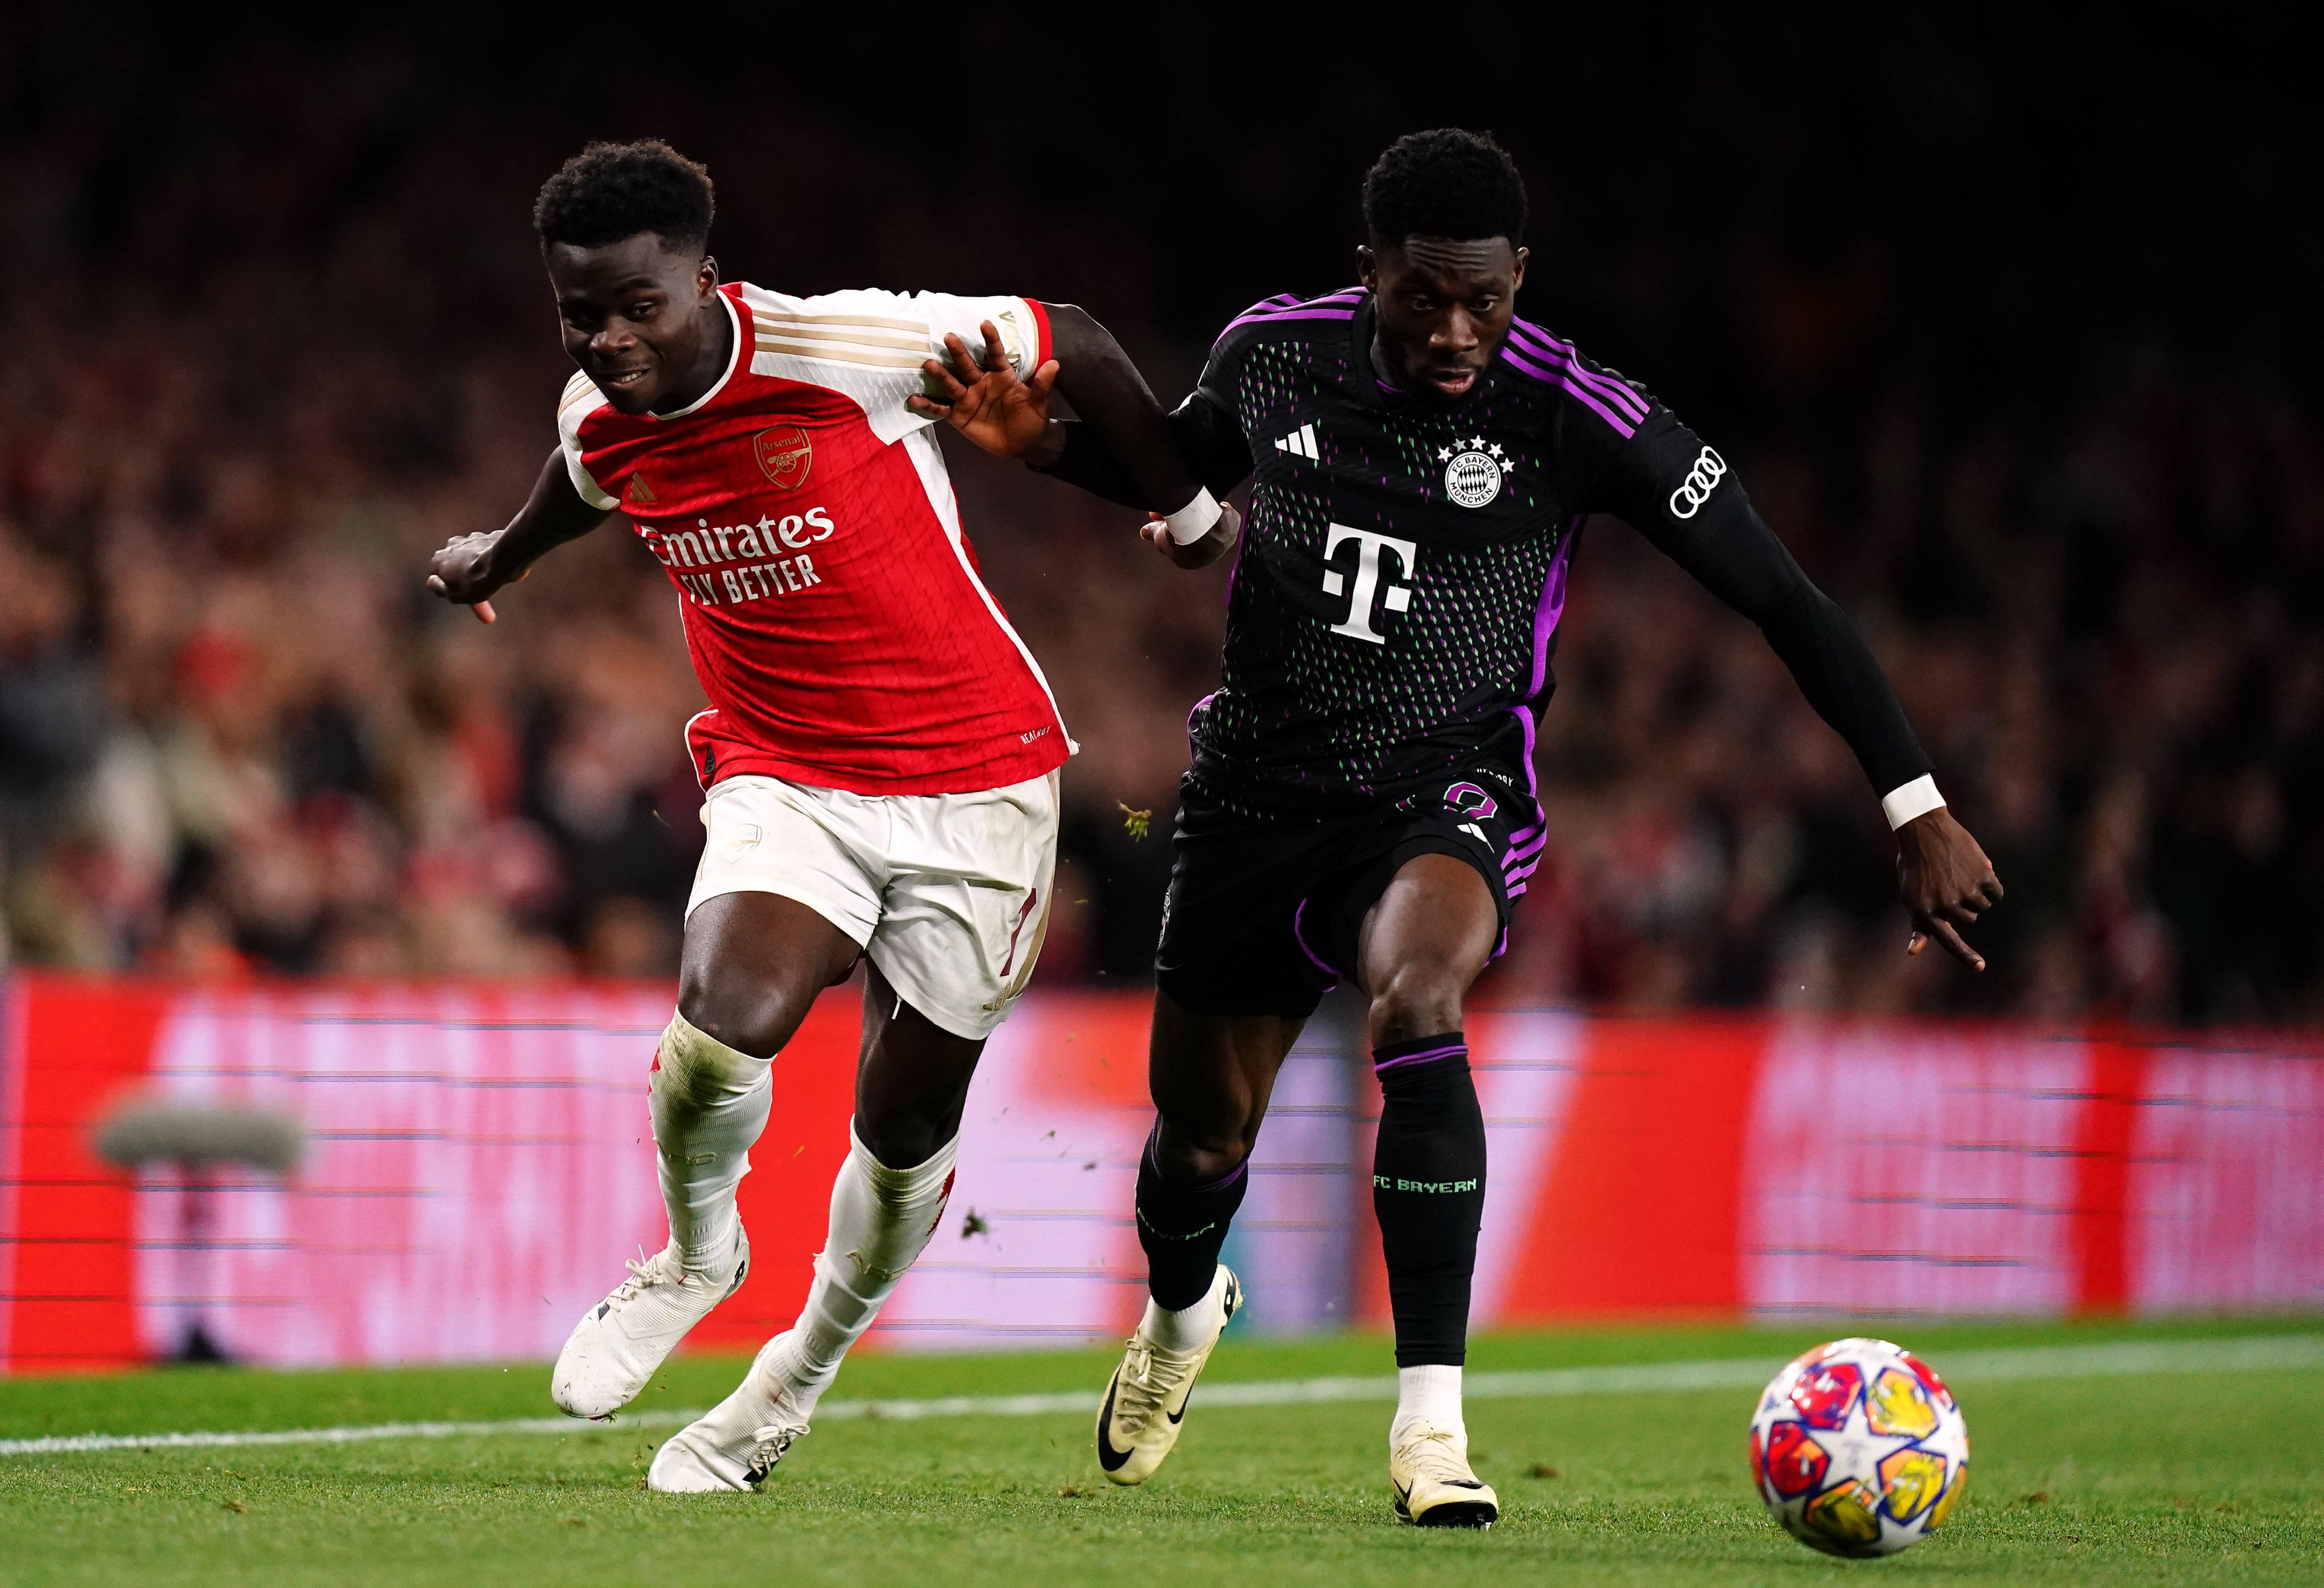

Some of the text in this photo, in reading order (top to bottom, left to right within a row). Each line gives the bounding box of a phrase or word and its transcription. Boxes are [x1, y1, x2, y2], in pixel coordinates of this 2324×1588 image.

[763, 434, 801, 451] Arsenal
[1452, 456, 1496, 478] FC BAYERN
[640, 507, 835, 567] Emirates
[721, 554, 822, 604] BETTER
[1323, 522, 1417, 645] T
[1373, 1175, 1477, 1193] FC BAYERN
